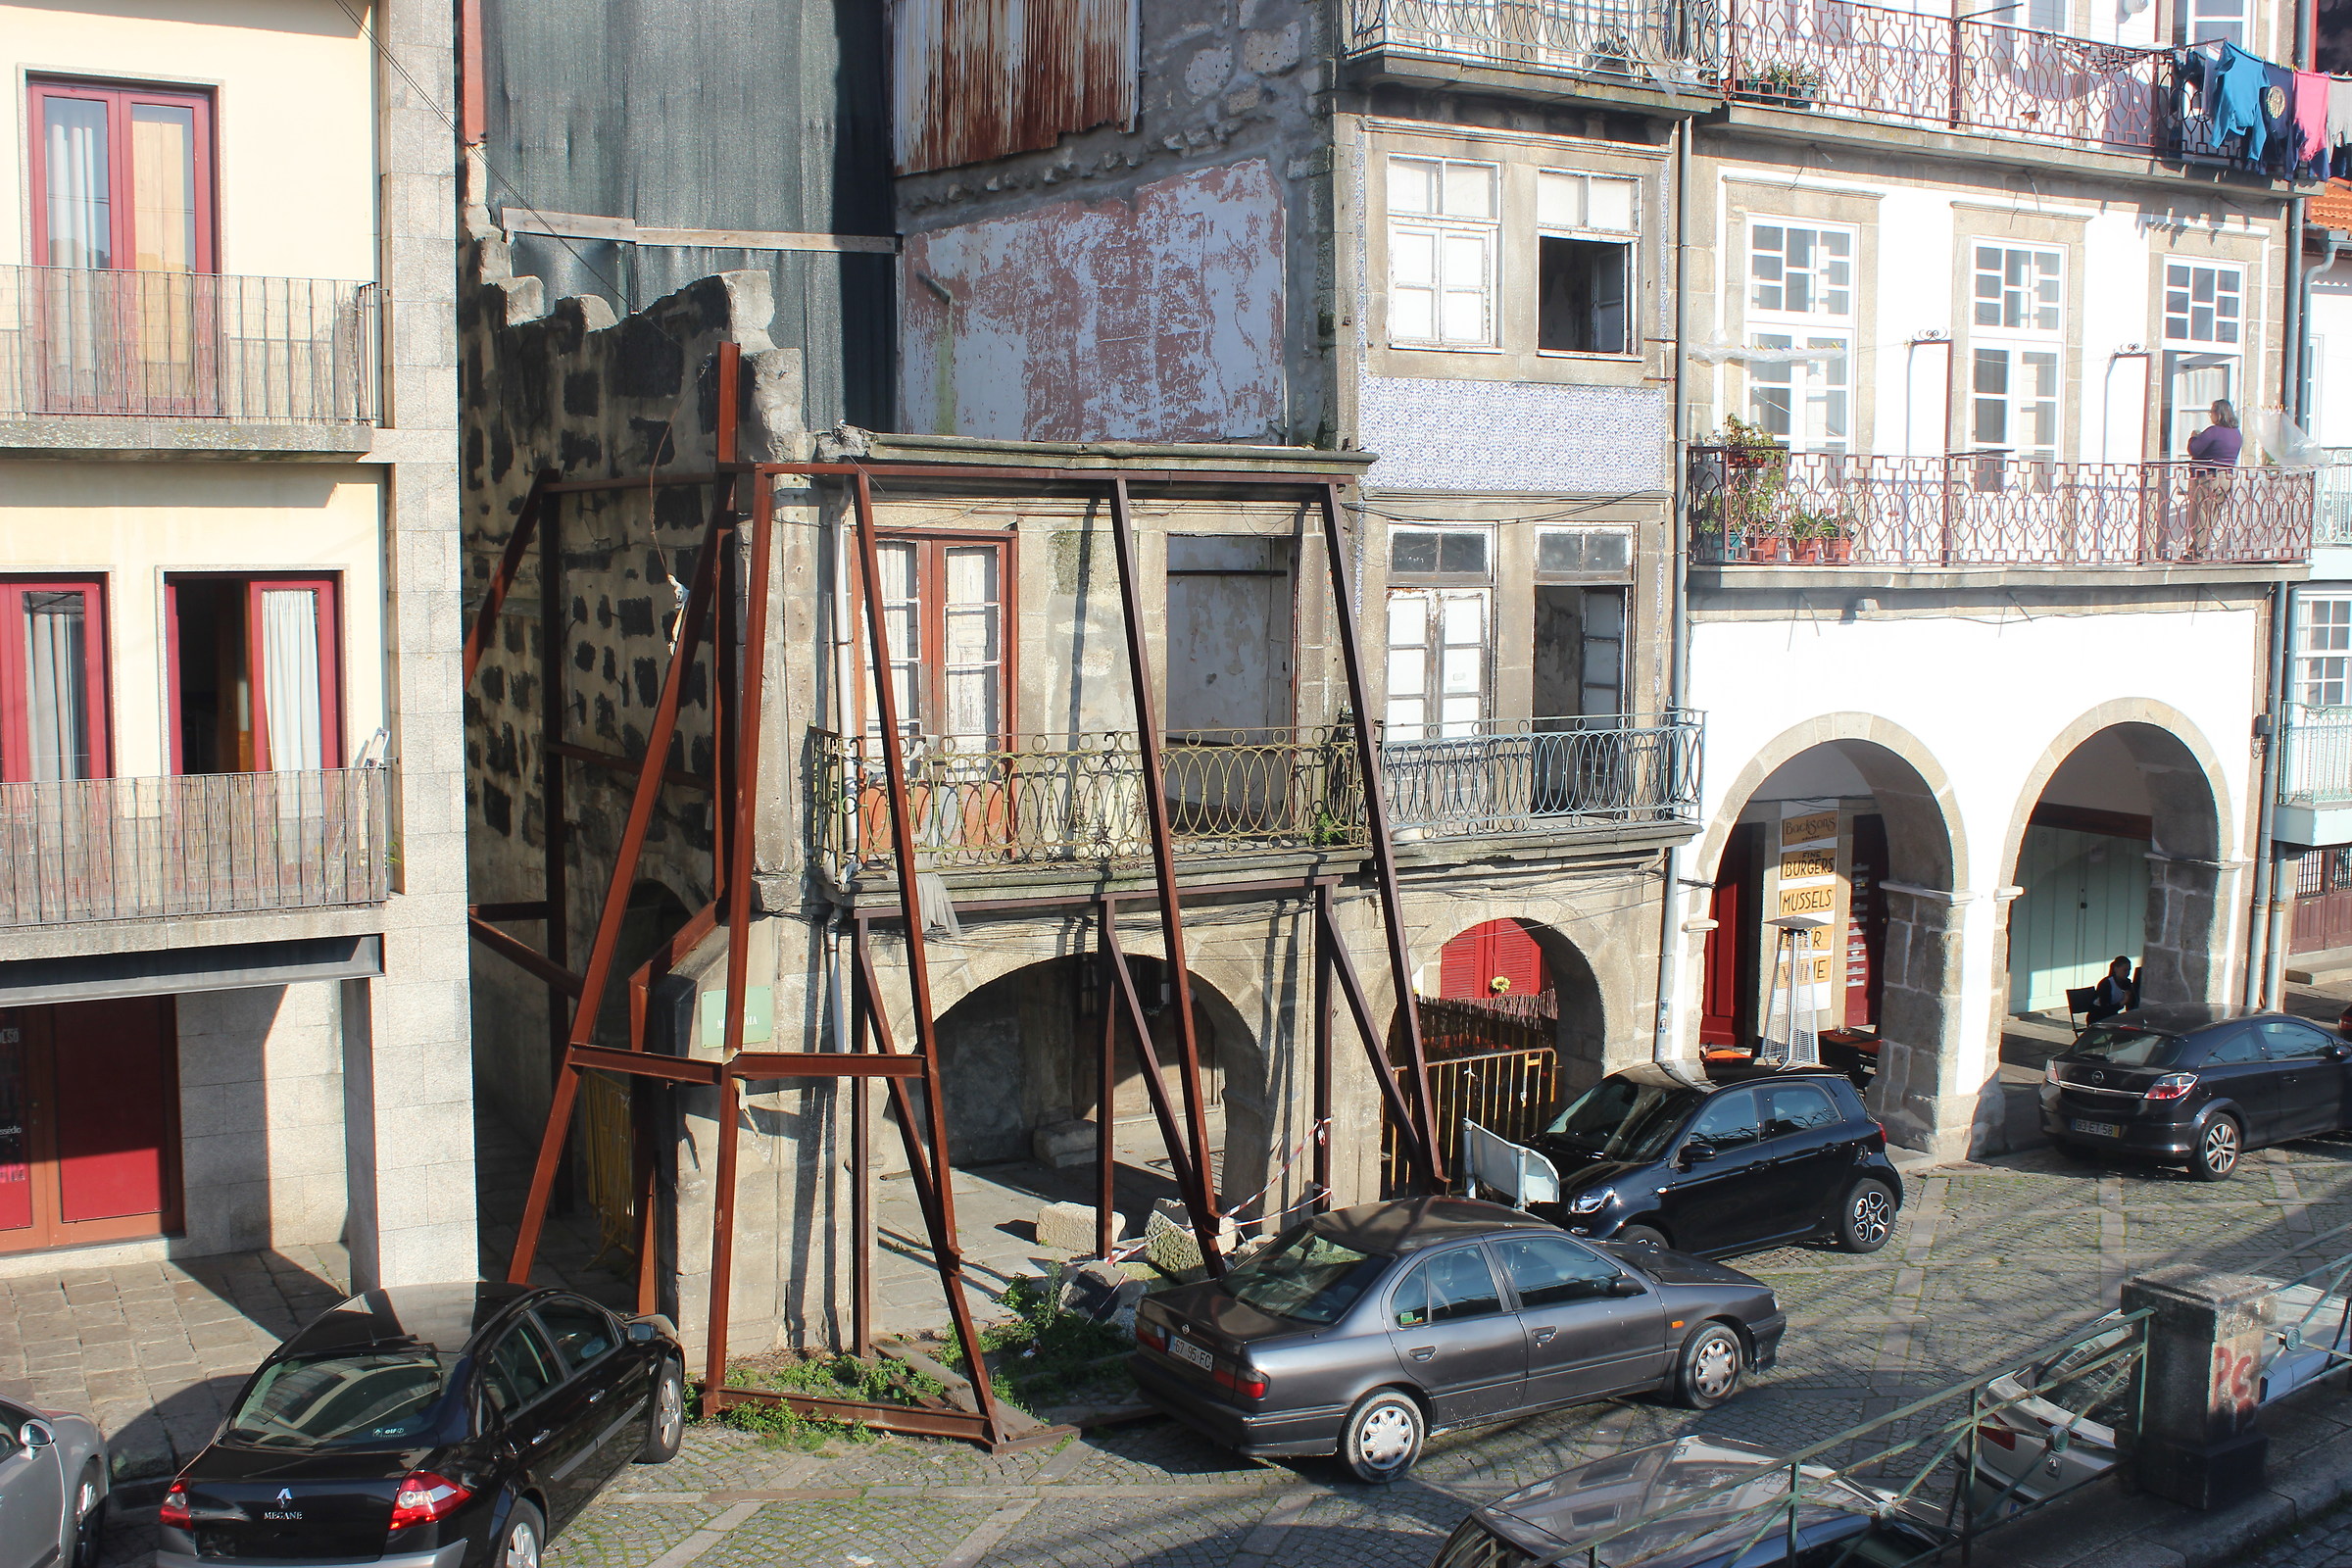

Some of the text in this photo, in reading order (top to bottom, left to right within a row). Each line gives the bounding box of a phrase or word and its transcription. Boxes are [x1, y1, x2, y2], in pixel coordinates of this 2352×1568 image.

[1786, 858, 1835, 877] BURGERS
[1782, 889, 1833, 913] MUSSELS
[264, 1511, 303, 1520] MEGANE
